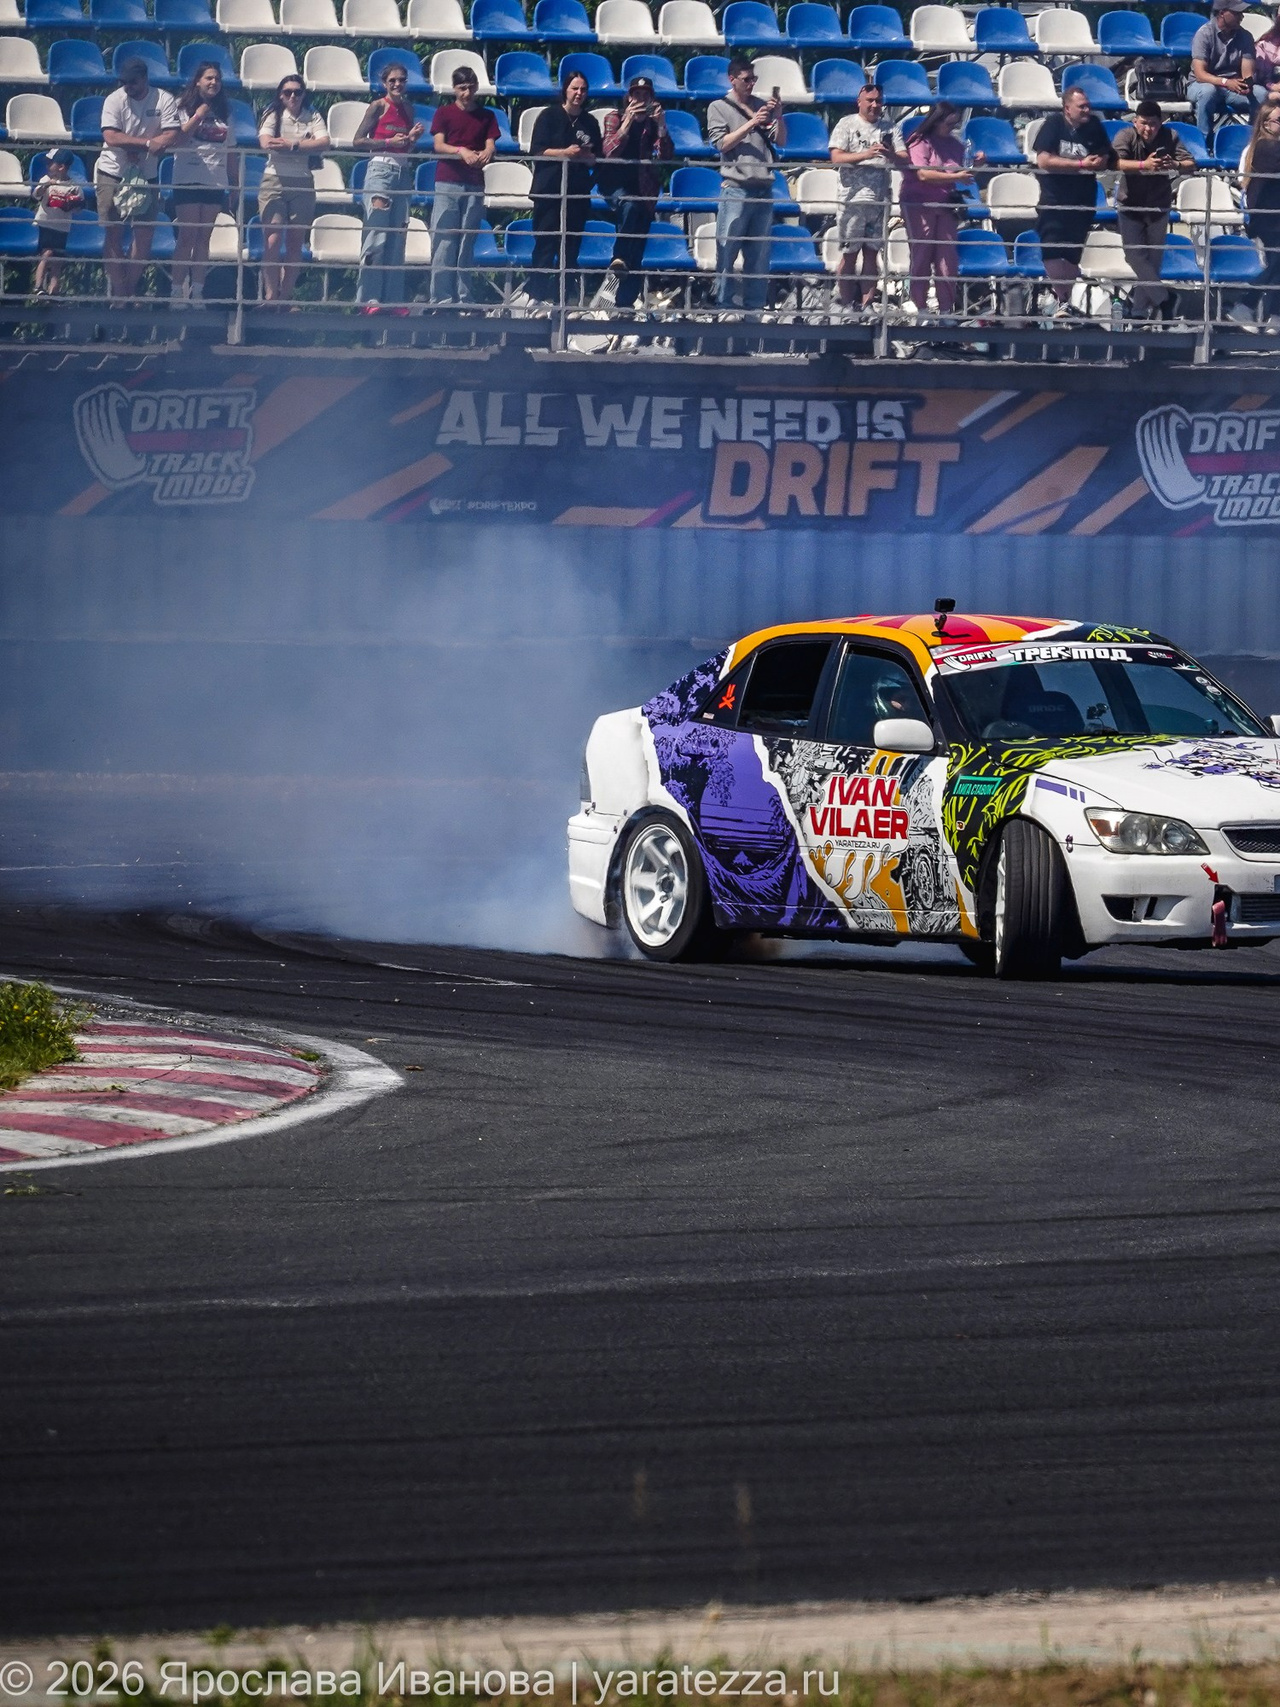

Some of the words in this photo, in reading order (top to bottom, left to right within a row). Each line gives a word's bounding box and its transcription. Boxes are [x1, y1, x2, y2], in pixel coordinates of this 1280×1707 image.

[131, 397, 248, 432] DRIFT
[435, 390, 566, 446] ALL
[576, 393, 692, 449] WE
[699, 398, 845, 450] NEED
[856, 399, 906, 439] IS
[149, 450, 243, 475] TRACK
[162, 474, 247, 498] MODE
[708, 441, 961, 517] DRIFT
[959, 650, 993, 662] DRIFT
[828, 776, 897, 807] IVAN
[809, 806, 909, 840] VILAER
